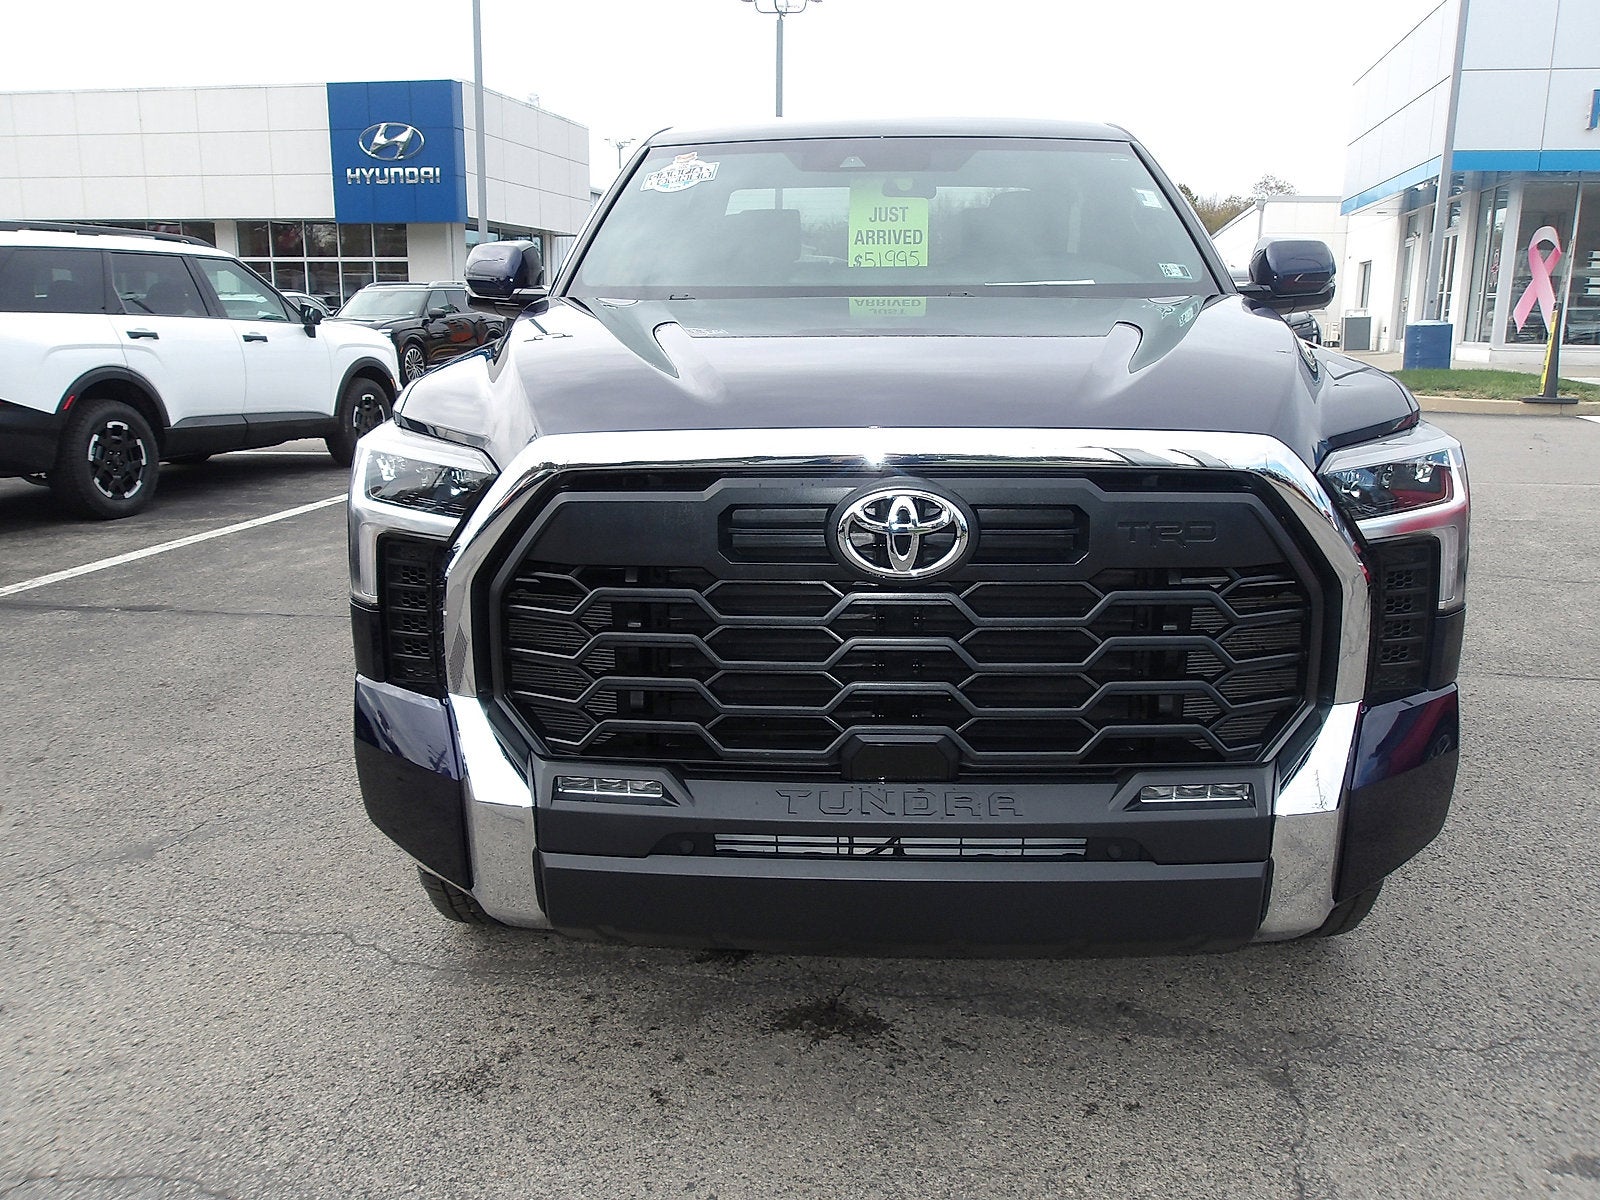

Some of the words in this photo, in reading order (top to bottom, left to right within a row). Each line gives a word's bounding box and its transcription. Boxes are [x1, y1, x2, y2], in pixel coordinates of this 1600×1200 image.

[346, 166, 441, 185] HYUNDAI
[868, 206, 909, 223] JUST
[853, 229, 923, 245] ARRIVED
[1117, 521, 1217, 549] TRD
[776, 789, 1024, 817] TUNDRA
